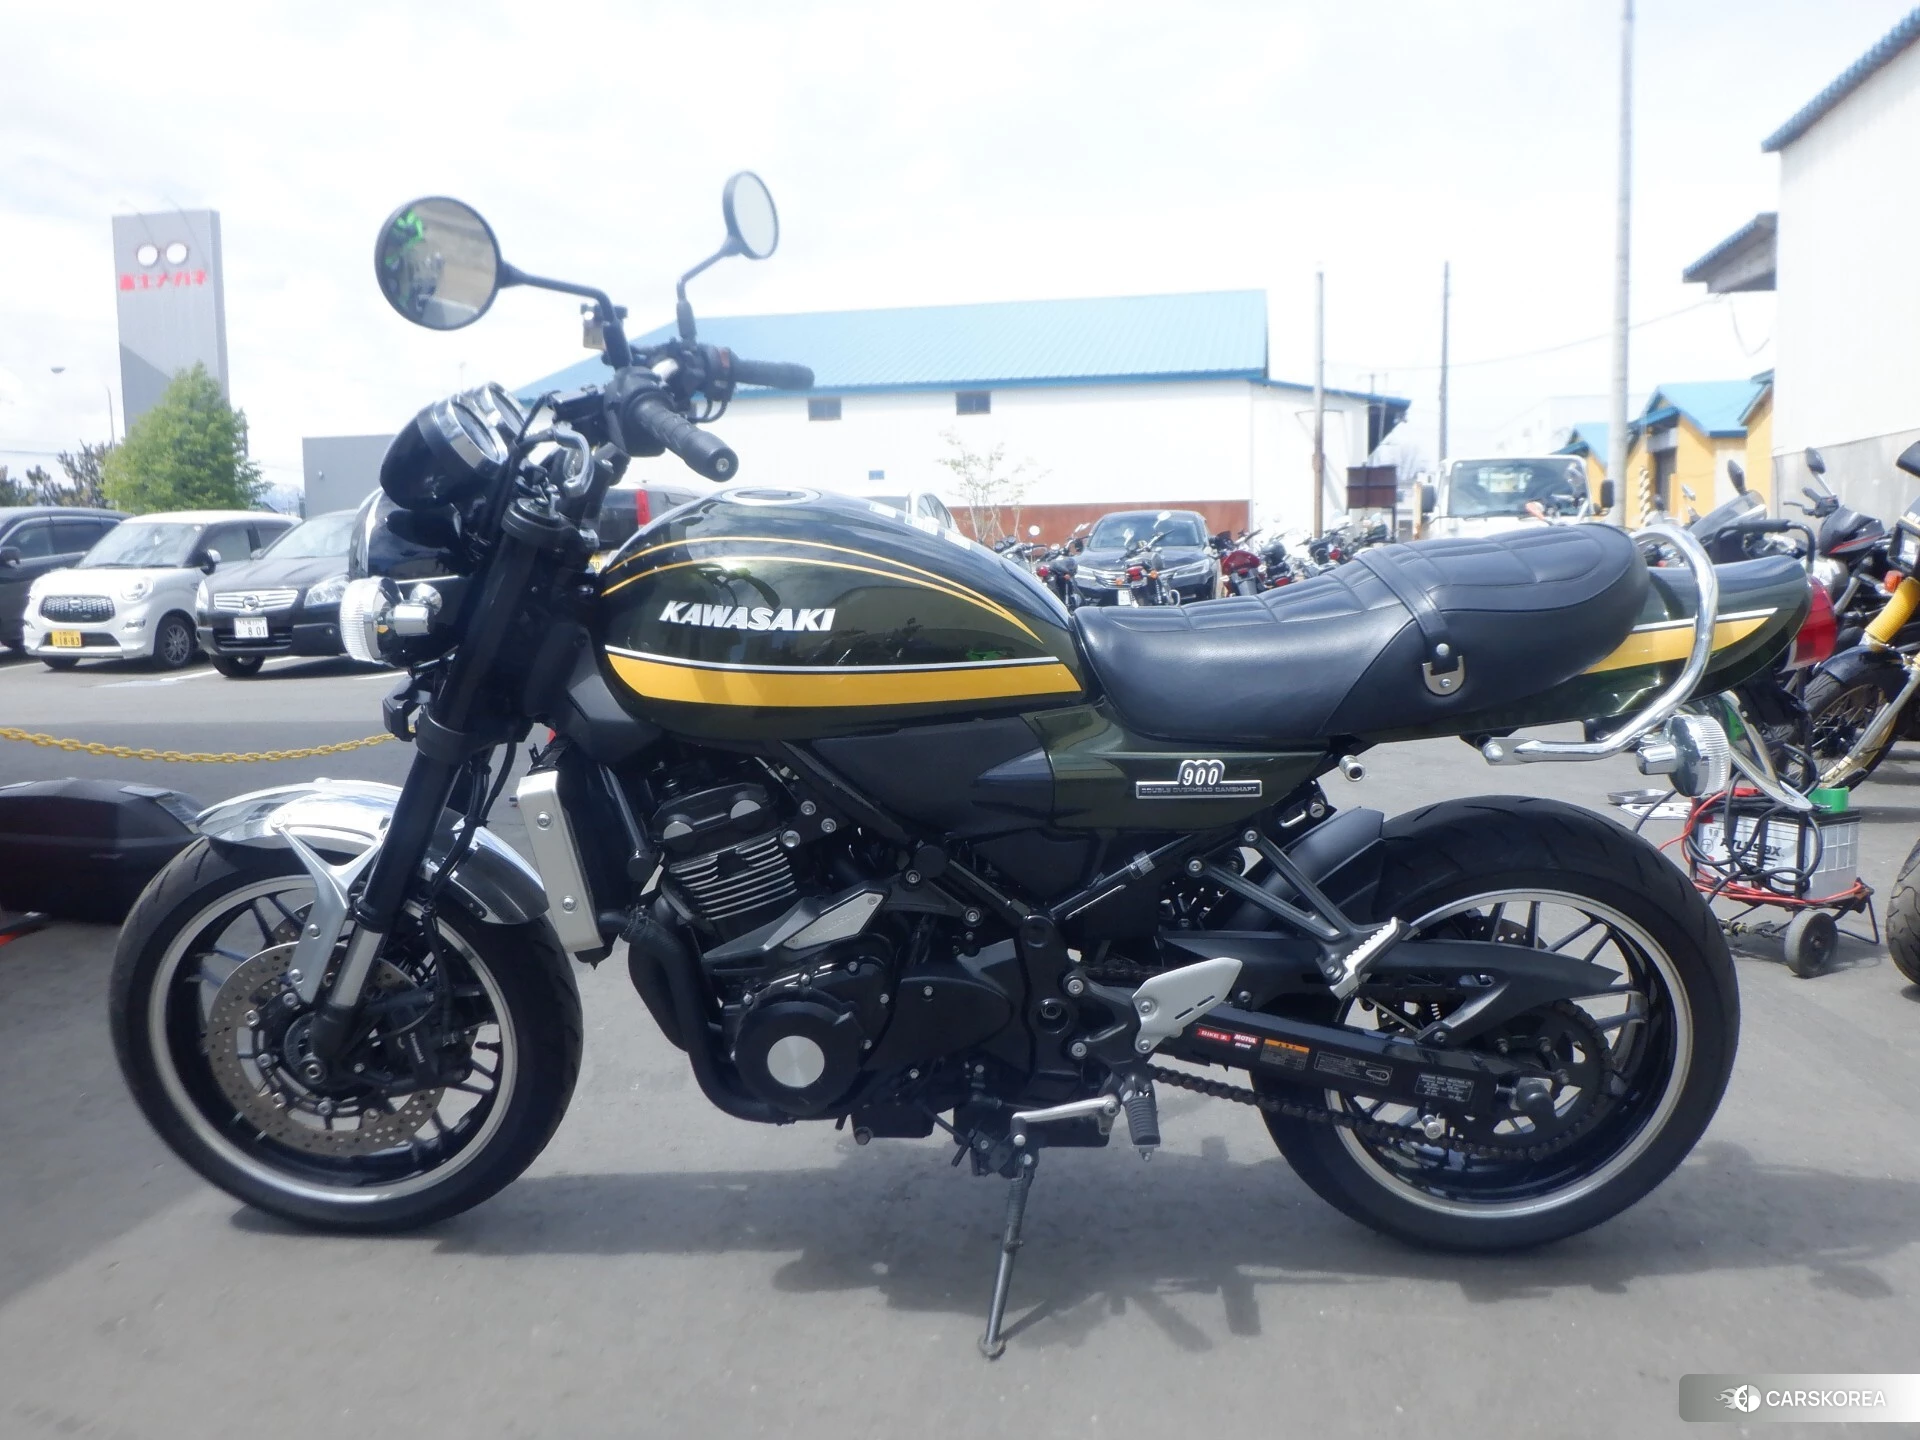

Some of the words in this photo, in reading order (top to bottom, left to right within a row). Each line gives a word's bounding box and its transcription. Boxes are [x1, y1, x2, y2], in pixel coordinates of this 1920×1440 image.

[658, 600, 836, 631] KAWASAKI
[1182, 767, 1219, 786] 900
[1215, 785, 1257, 793] CAMSHAFT
[1233, 1033, 1258, 1045] MOTUL
